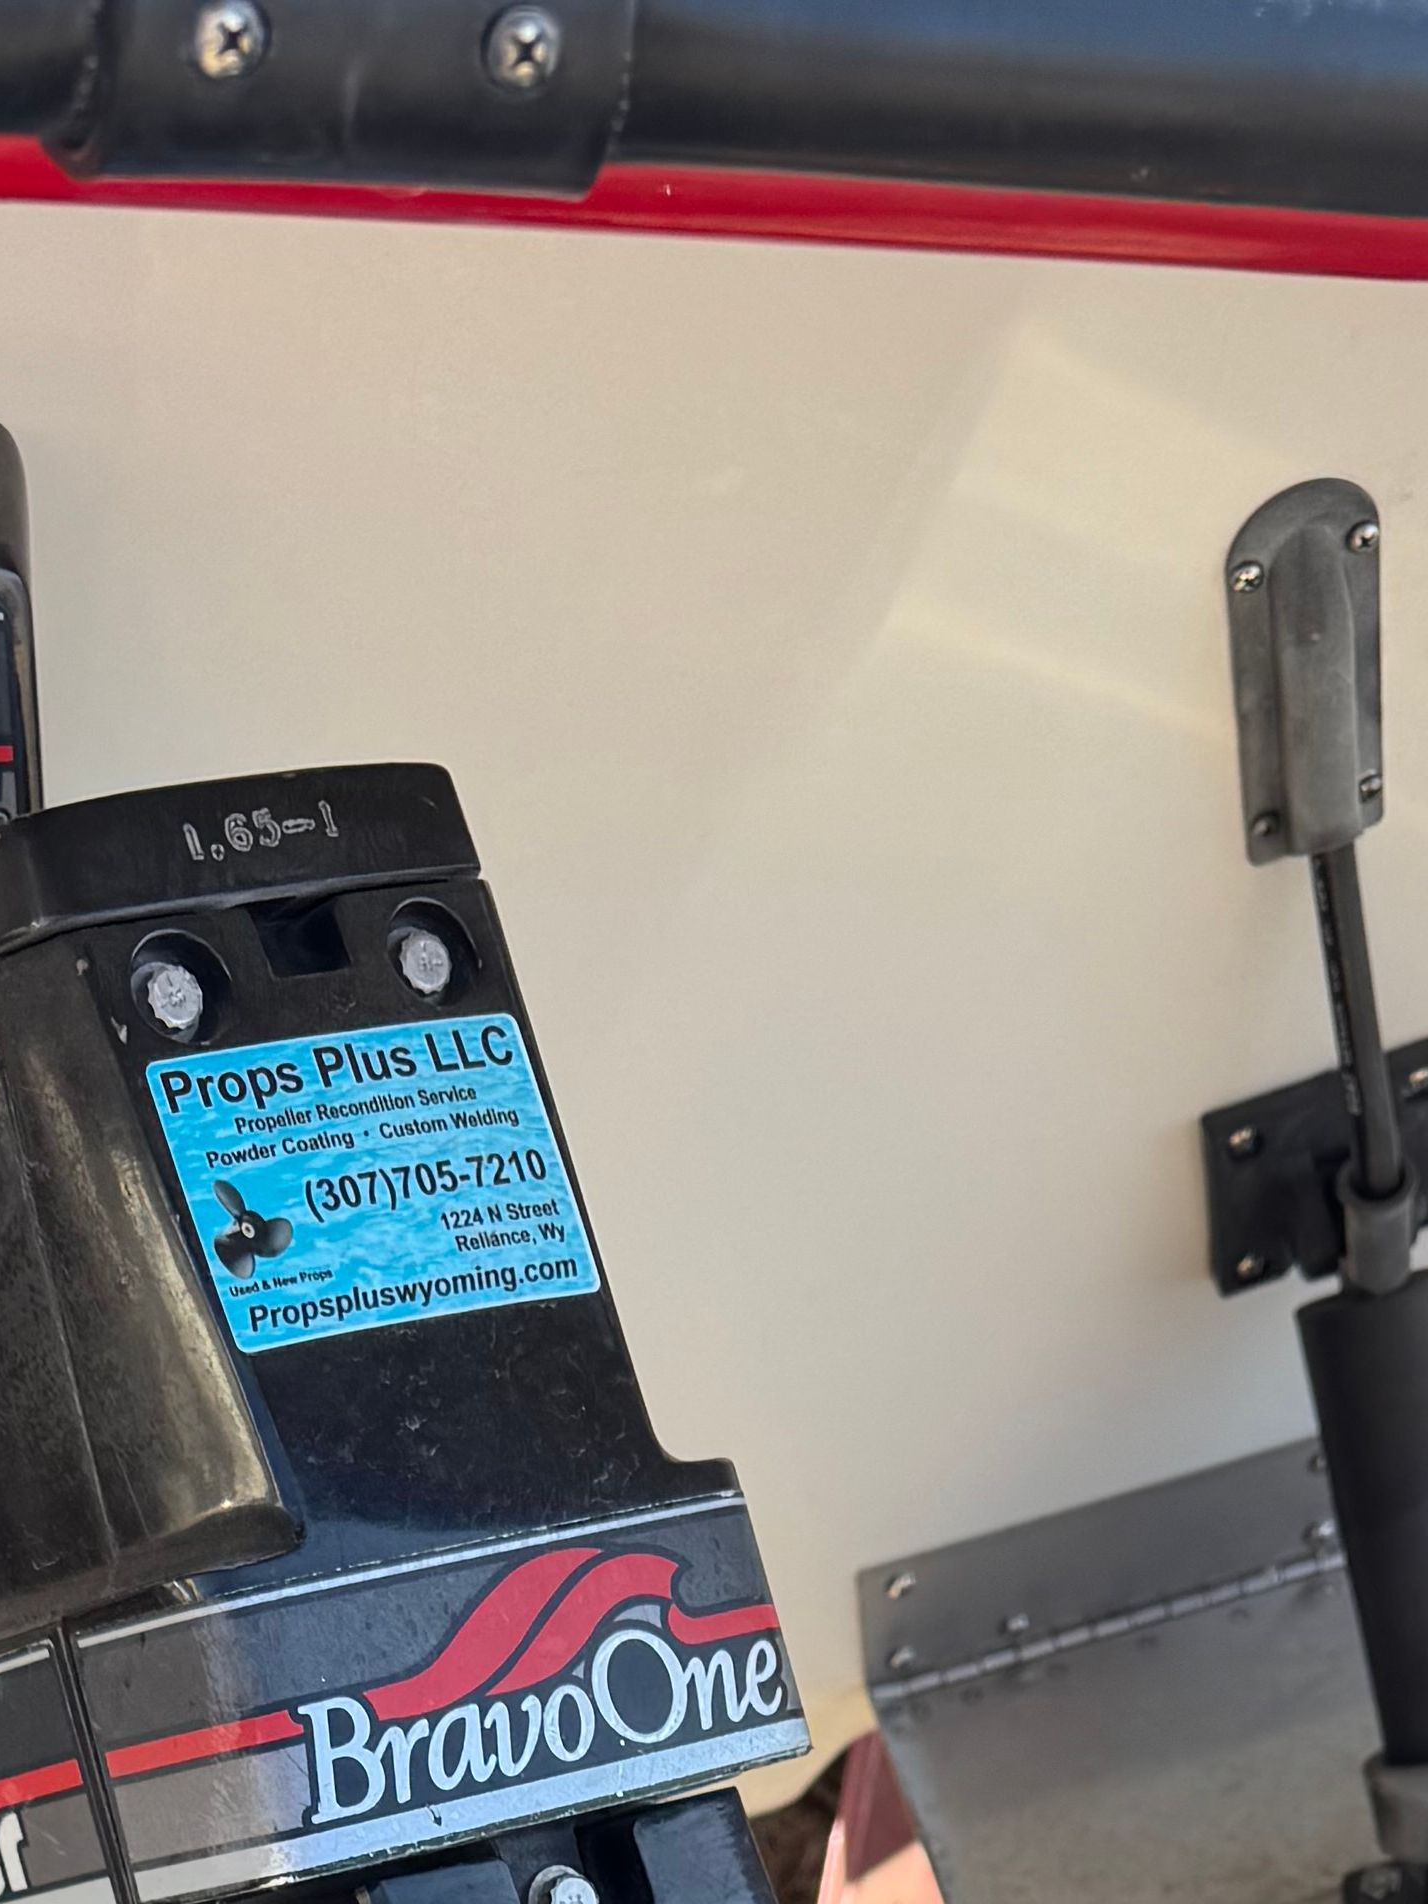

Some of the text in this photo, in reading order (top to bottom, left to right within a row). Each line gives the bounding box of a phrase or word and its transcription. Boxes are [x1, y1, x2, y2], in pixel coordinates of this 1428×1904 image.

[183, 800, 339, 861] 1.65-1
[159, 1025, 514, 1114] Props Plus LLC
[205, 1107, 519, 1169] Powder Coating Custom Welding
[234, 1085, 477, 1135] Propeller Recondition Service
[304, 1149, 547, 1224] (307)705-7210
[440, 1198, 561, 1231] 1224 N Street
[454, 1222, 566, 1253] Reliance, Wy
[228, 1269, 334, 1298] Used & New Props
[249, 1257, 579, 1332] Propspluswyoming.com
